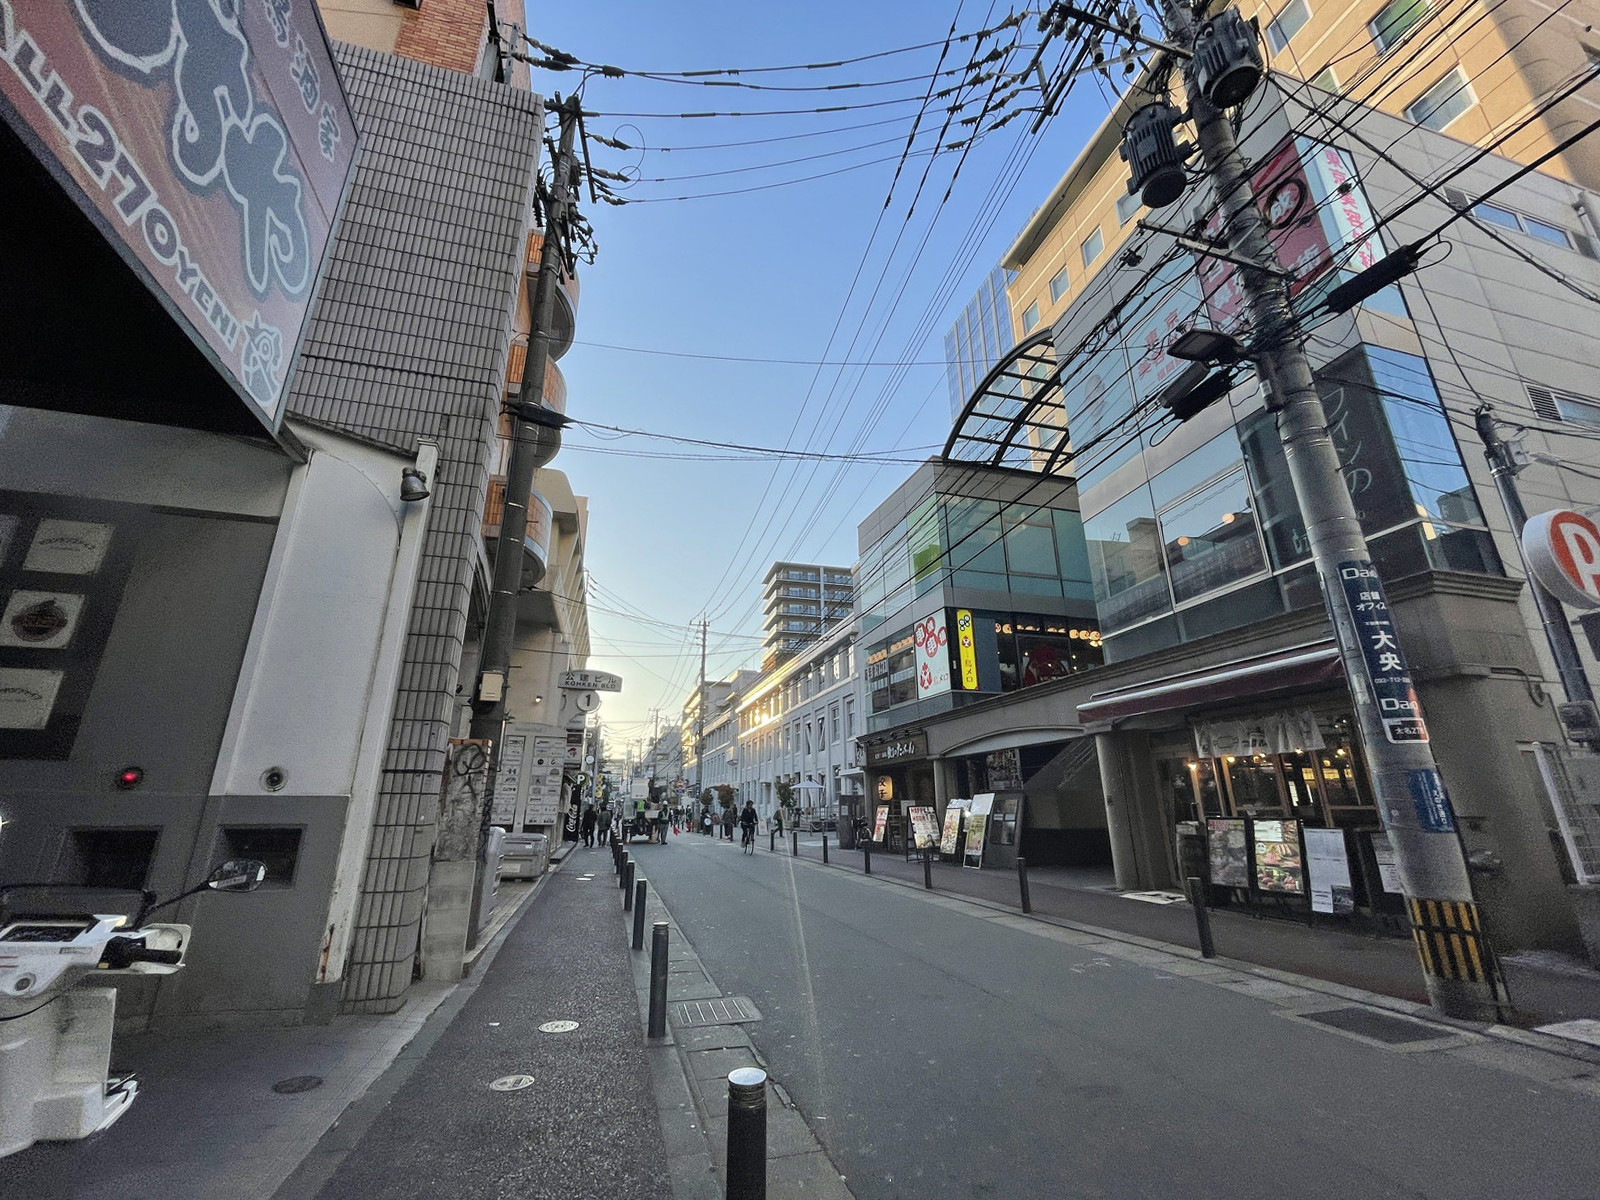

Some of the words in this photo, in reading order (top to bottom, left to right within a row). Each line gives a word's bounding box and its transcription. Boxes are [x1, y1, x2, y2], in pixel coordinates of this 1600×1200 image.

[1558, 521, 1600, 600] P
[1355, 601, 1387, 611] オフィス
[1370, 630, 1403, 672] 大央
[565, 671, 617, 684] 公建ビル
[585, 694, 591, 707] 1
